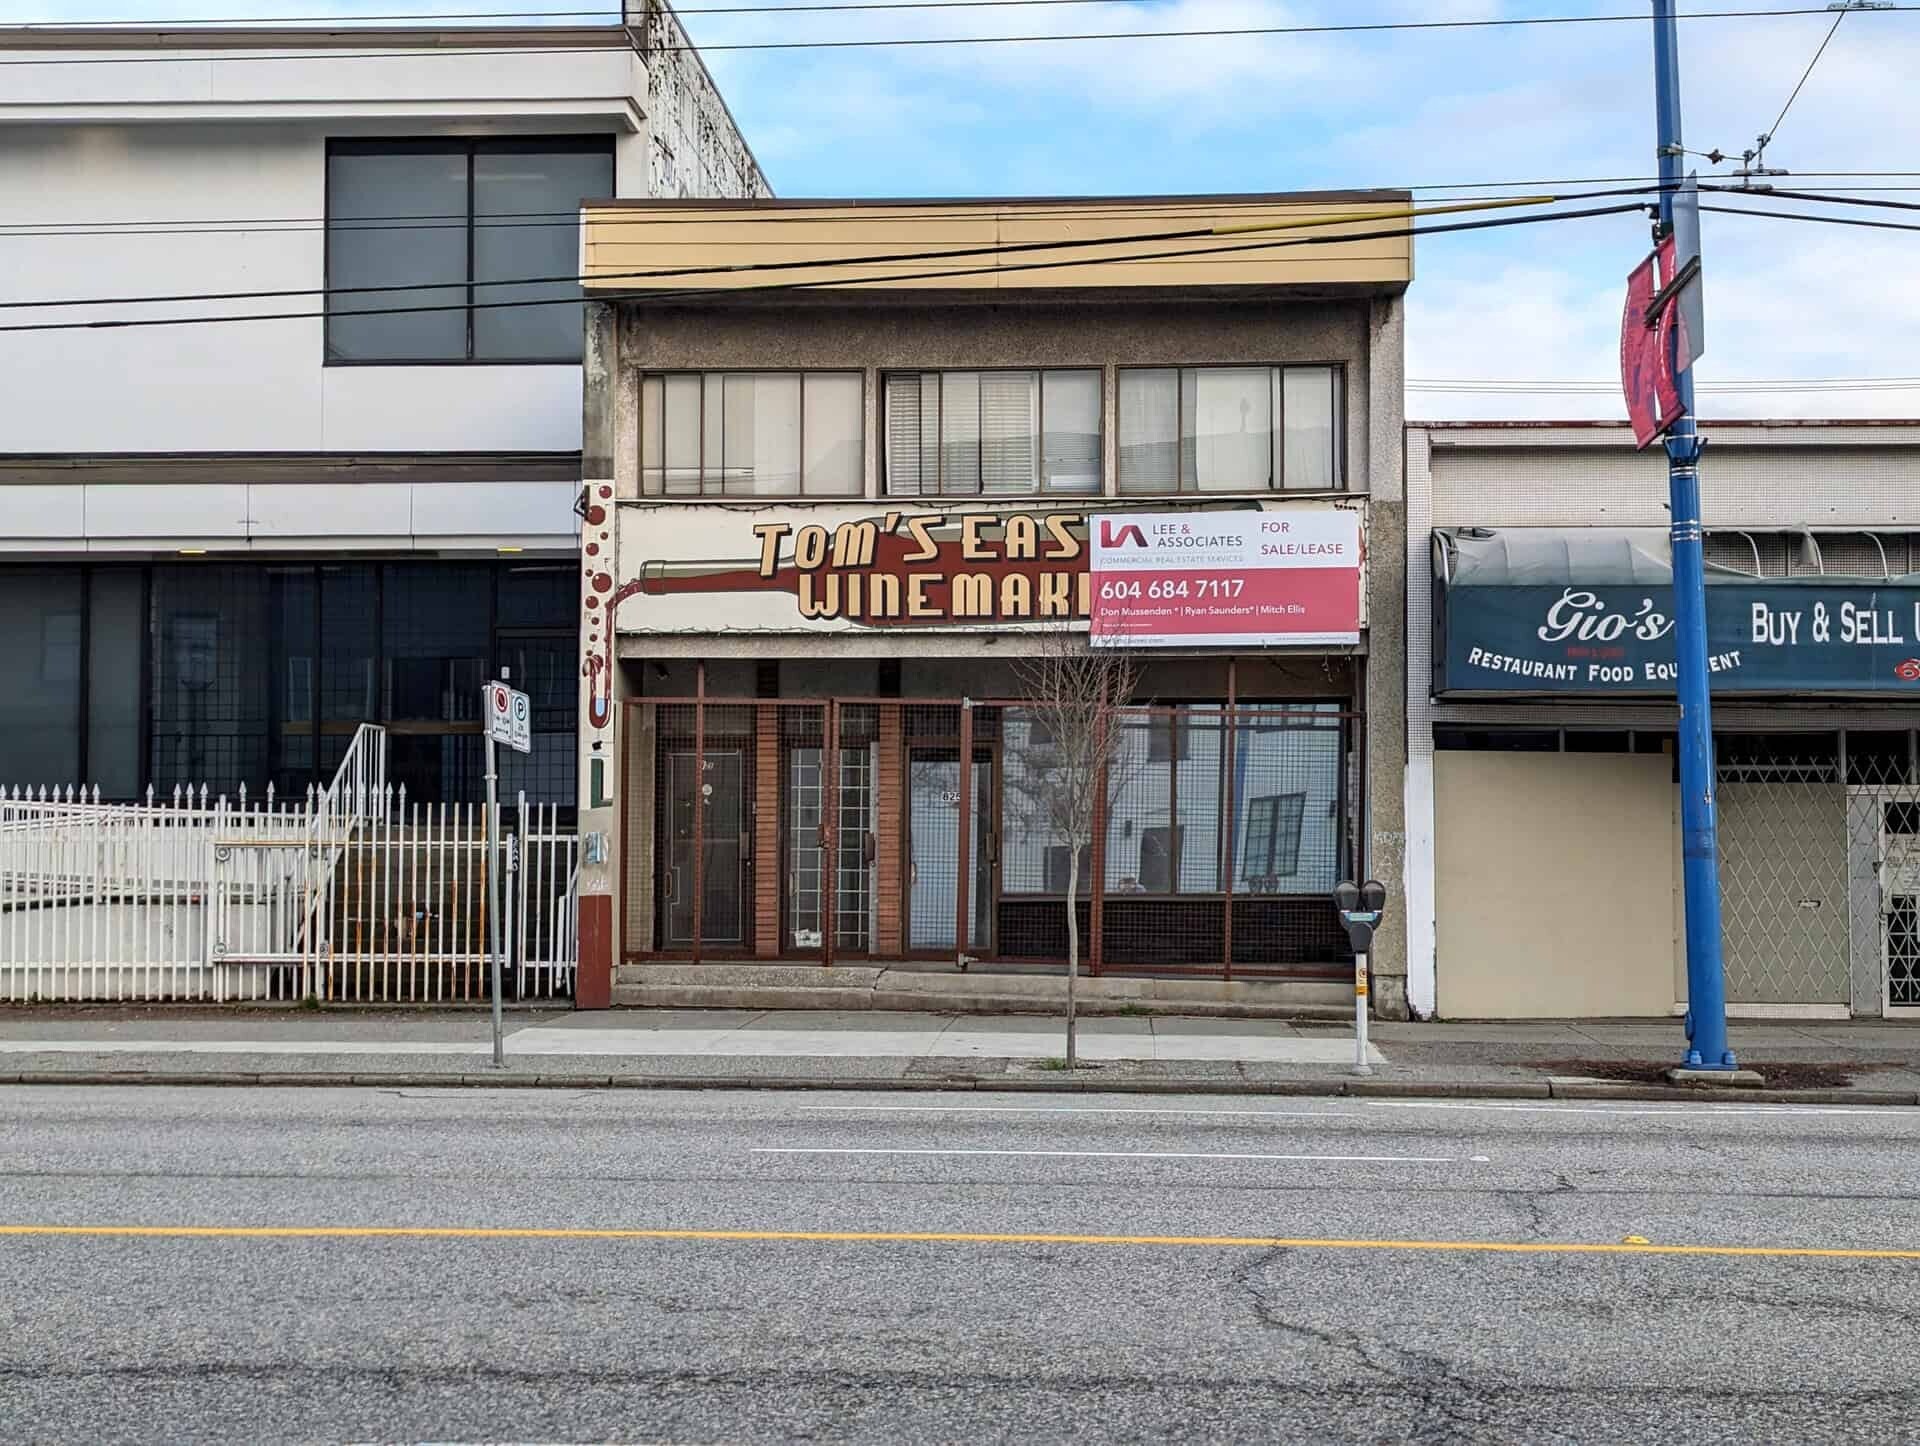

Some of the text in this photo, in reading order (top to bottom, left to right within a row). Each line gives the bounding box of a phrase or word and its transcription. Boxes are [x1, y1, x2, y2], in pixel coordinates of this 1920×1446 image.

[1152, 523, 1192, 535] LEE &
[1261, 521, 1290, 534] FOR
[754, 512, 1082, 577] TOM'S EAS
[1157, 535, 1243, 548] ASSOCIATES
[1261, 543, 1344, 556] SALE/LEASE
[1100, 579, 1245, 600] 604 684 7117
[1100, 607, 1119, 617] Don
[1121, 606, 1172, 616] Mussenden
[1185, 606, 1207, 618] Ryan
[1260, 604, 1286, 614] Mitch
[1287, 604, 1305, 614] Ellis
[1538, 587, 1675, 642] Gio's
[1752, 601, 1802, 645] BUY
[1812, 601, 1830, 643] &
[1840, 601, 1904, 644] SELL
[1468, 647, 1741, 682] RESTAURANT FOOD EQUENT
